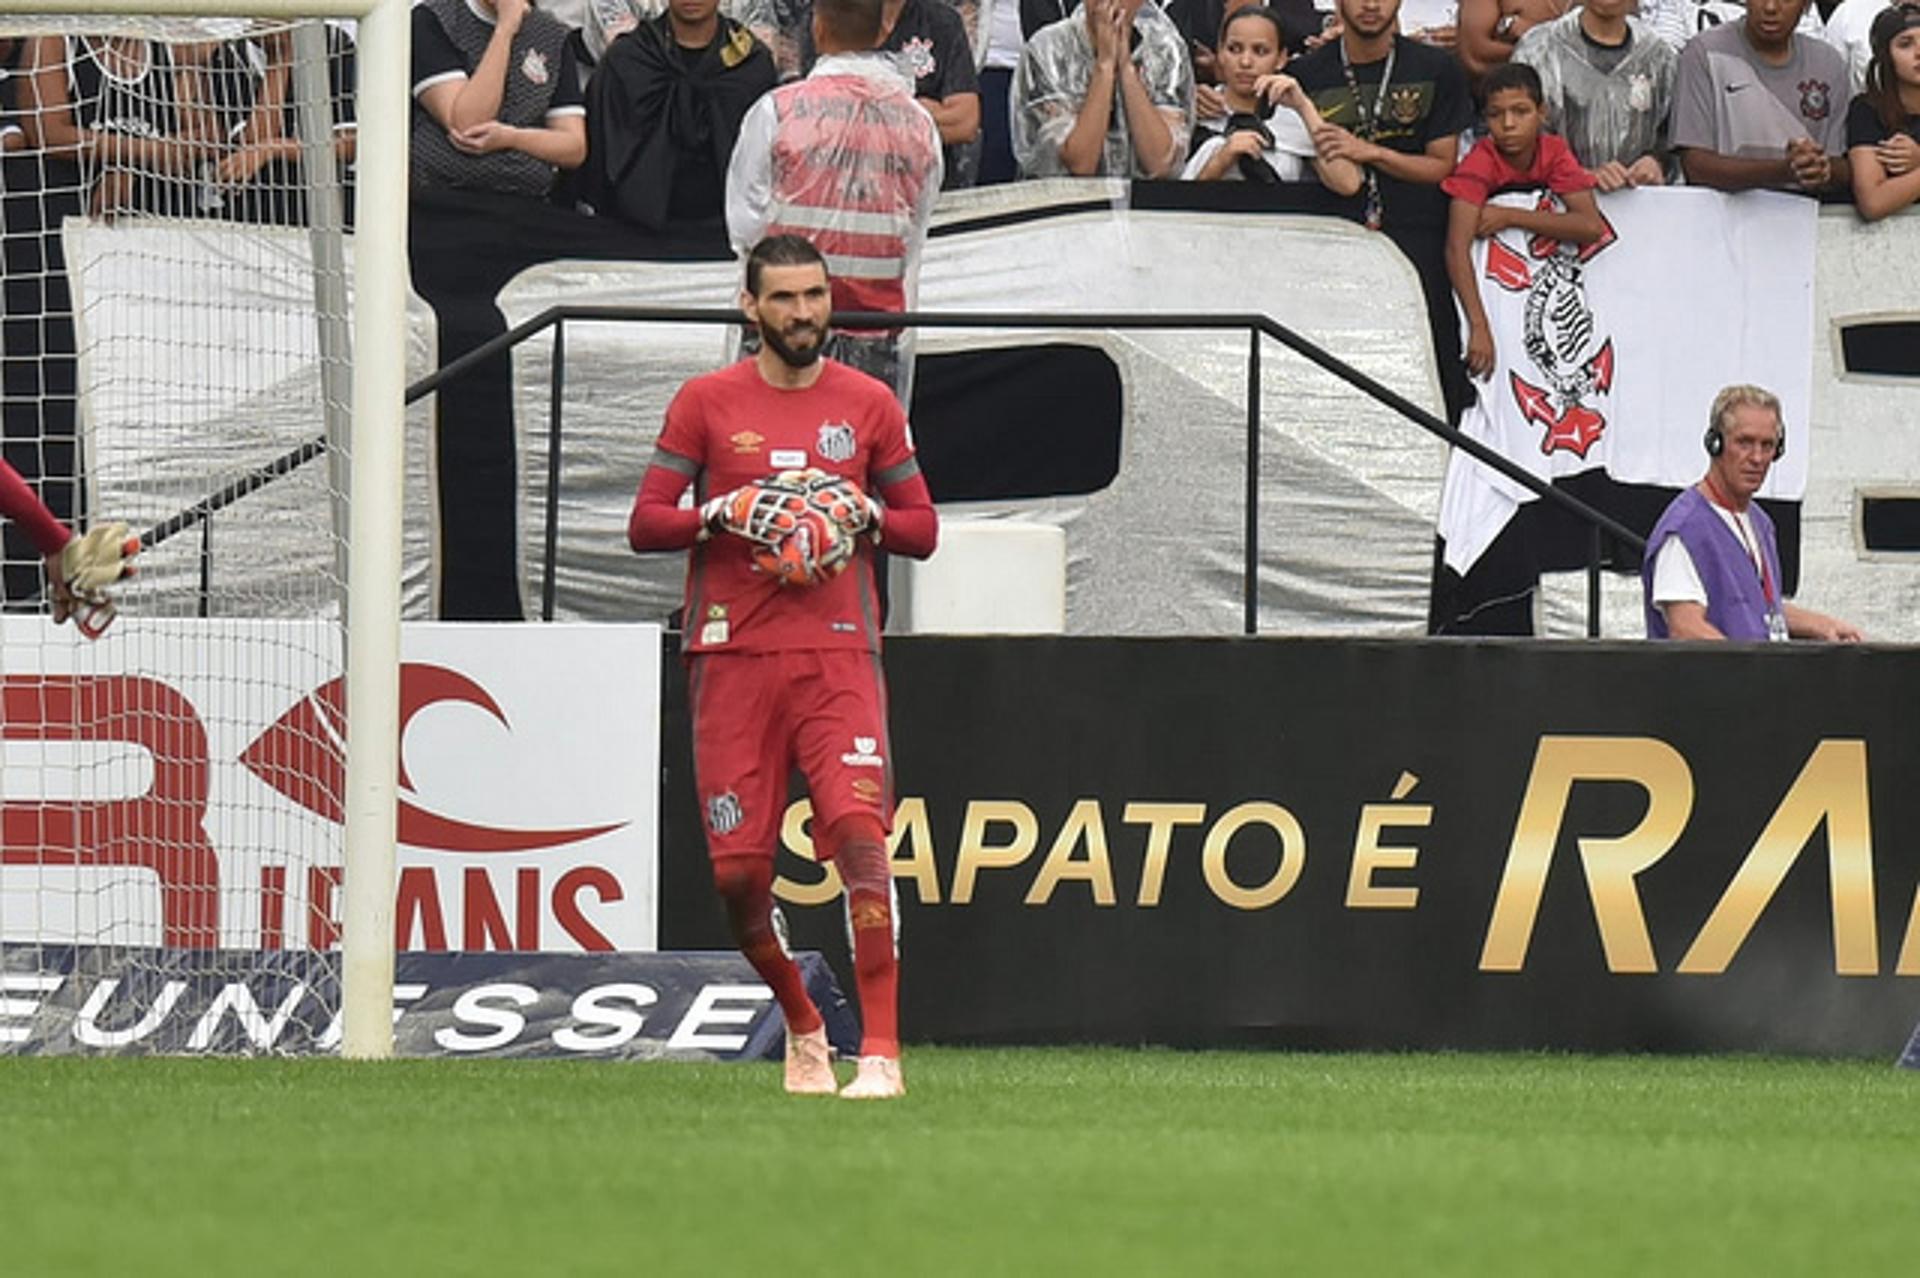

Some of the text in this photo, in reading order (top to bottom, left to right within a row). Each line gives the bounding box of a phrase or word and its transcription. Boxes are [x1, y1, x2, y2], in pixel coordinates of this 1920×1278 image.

[771, 734, 1920, 977] SAPATO É RA
